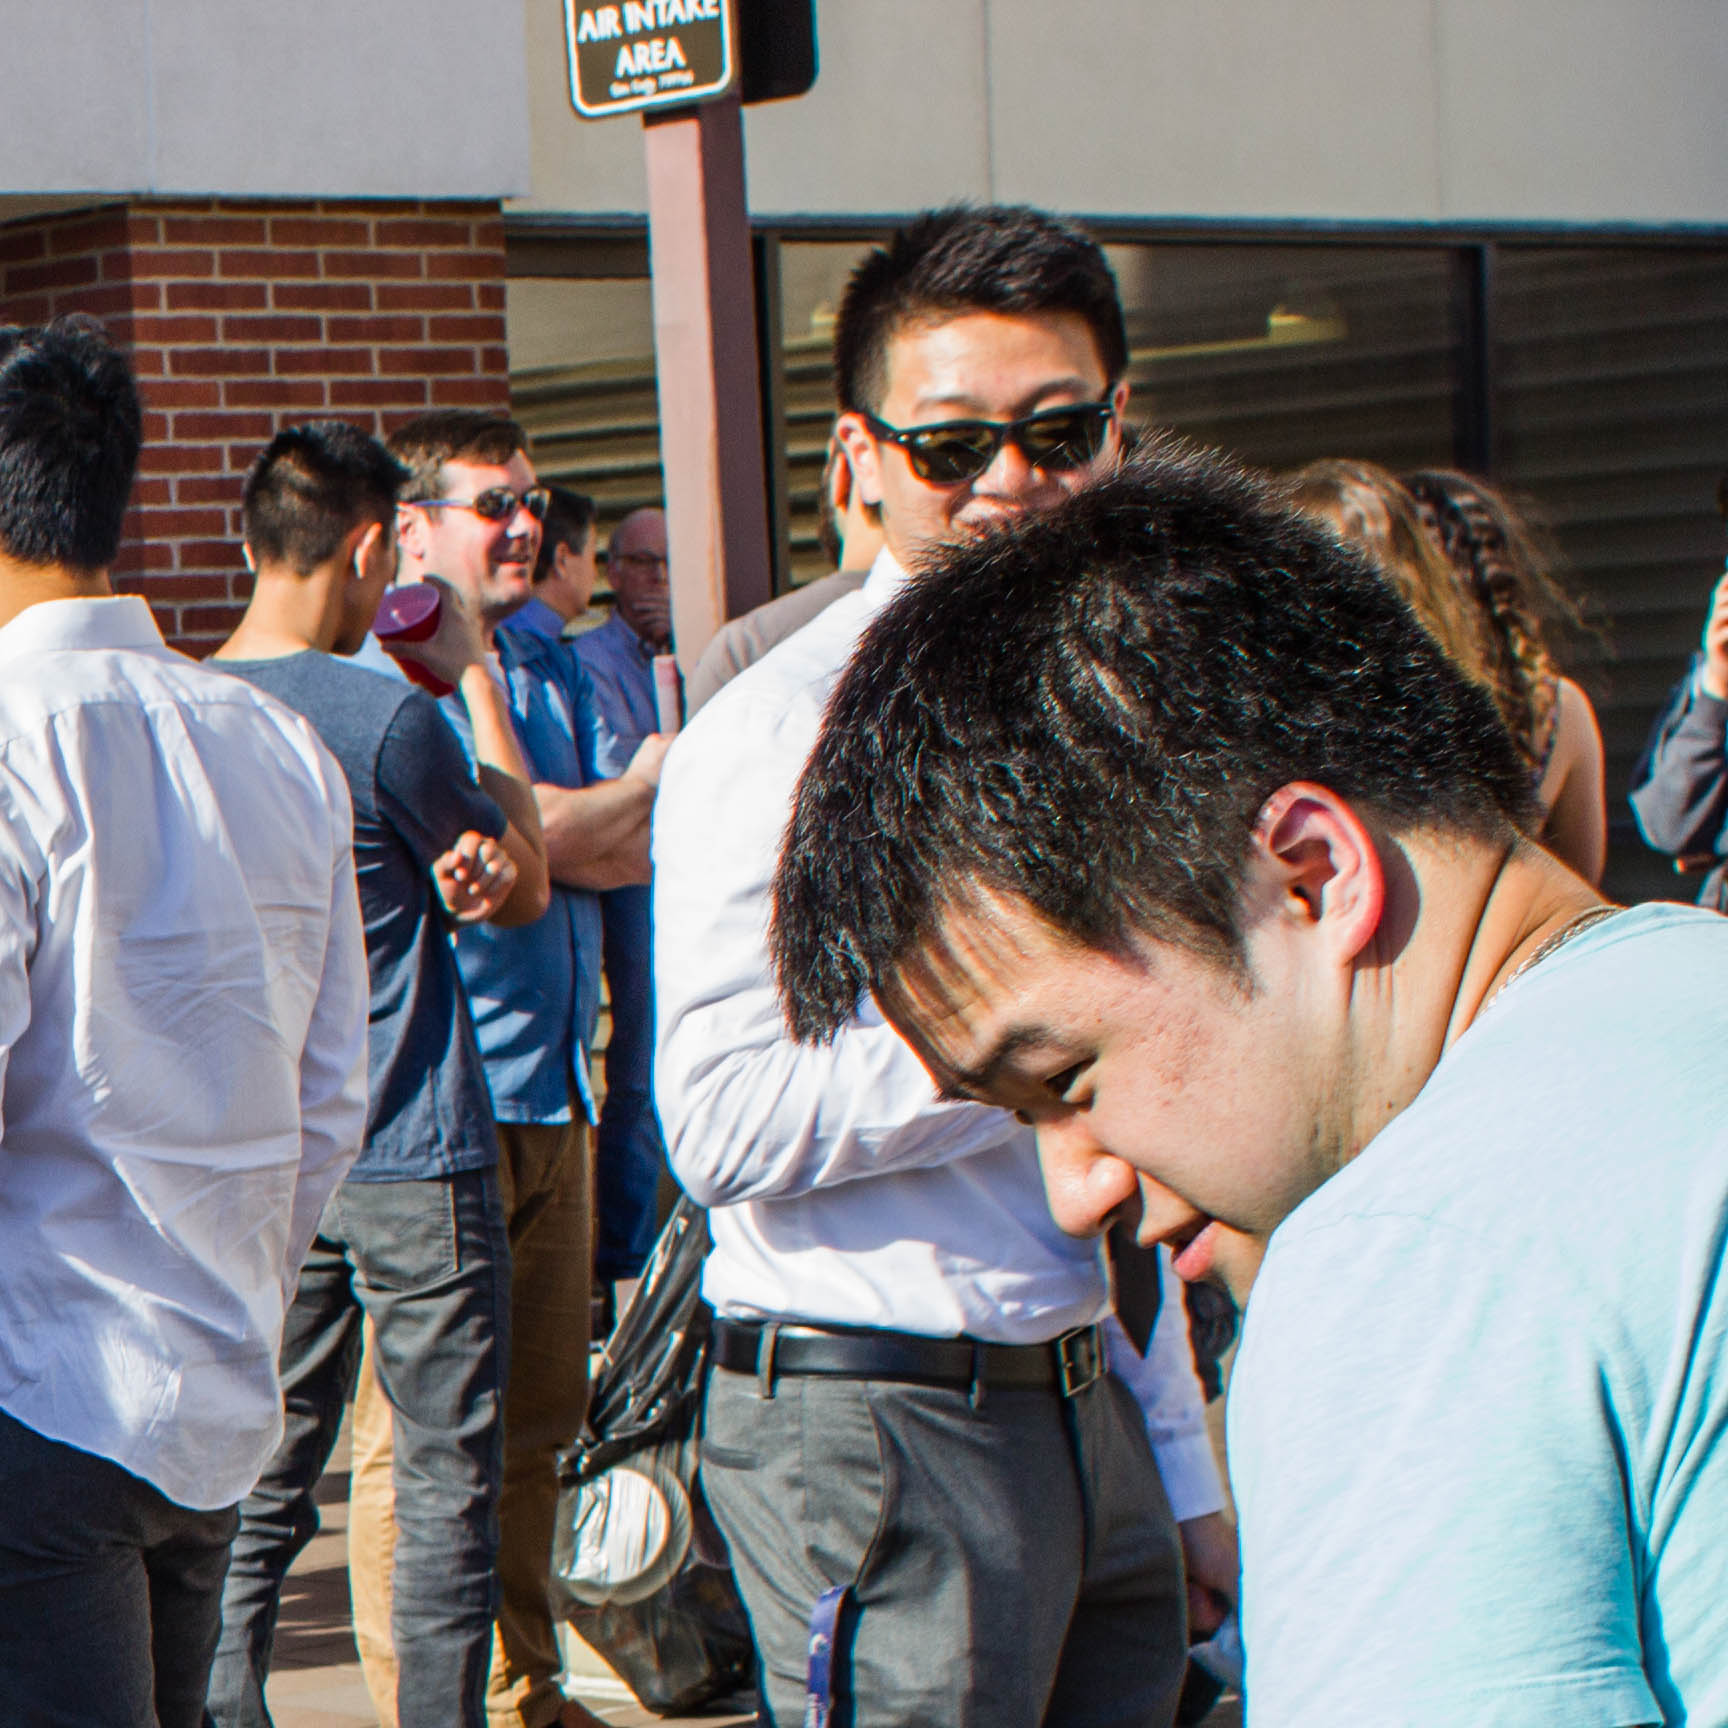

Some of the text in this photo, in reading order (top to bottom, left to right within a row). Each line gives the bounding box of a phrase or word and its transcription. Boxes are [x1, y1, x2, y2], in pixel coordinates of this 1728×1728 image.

[578, 0, 720, 43] AIR INTAKE
[615, 37, 687, 78] AREA
